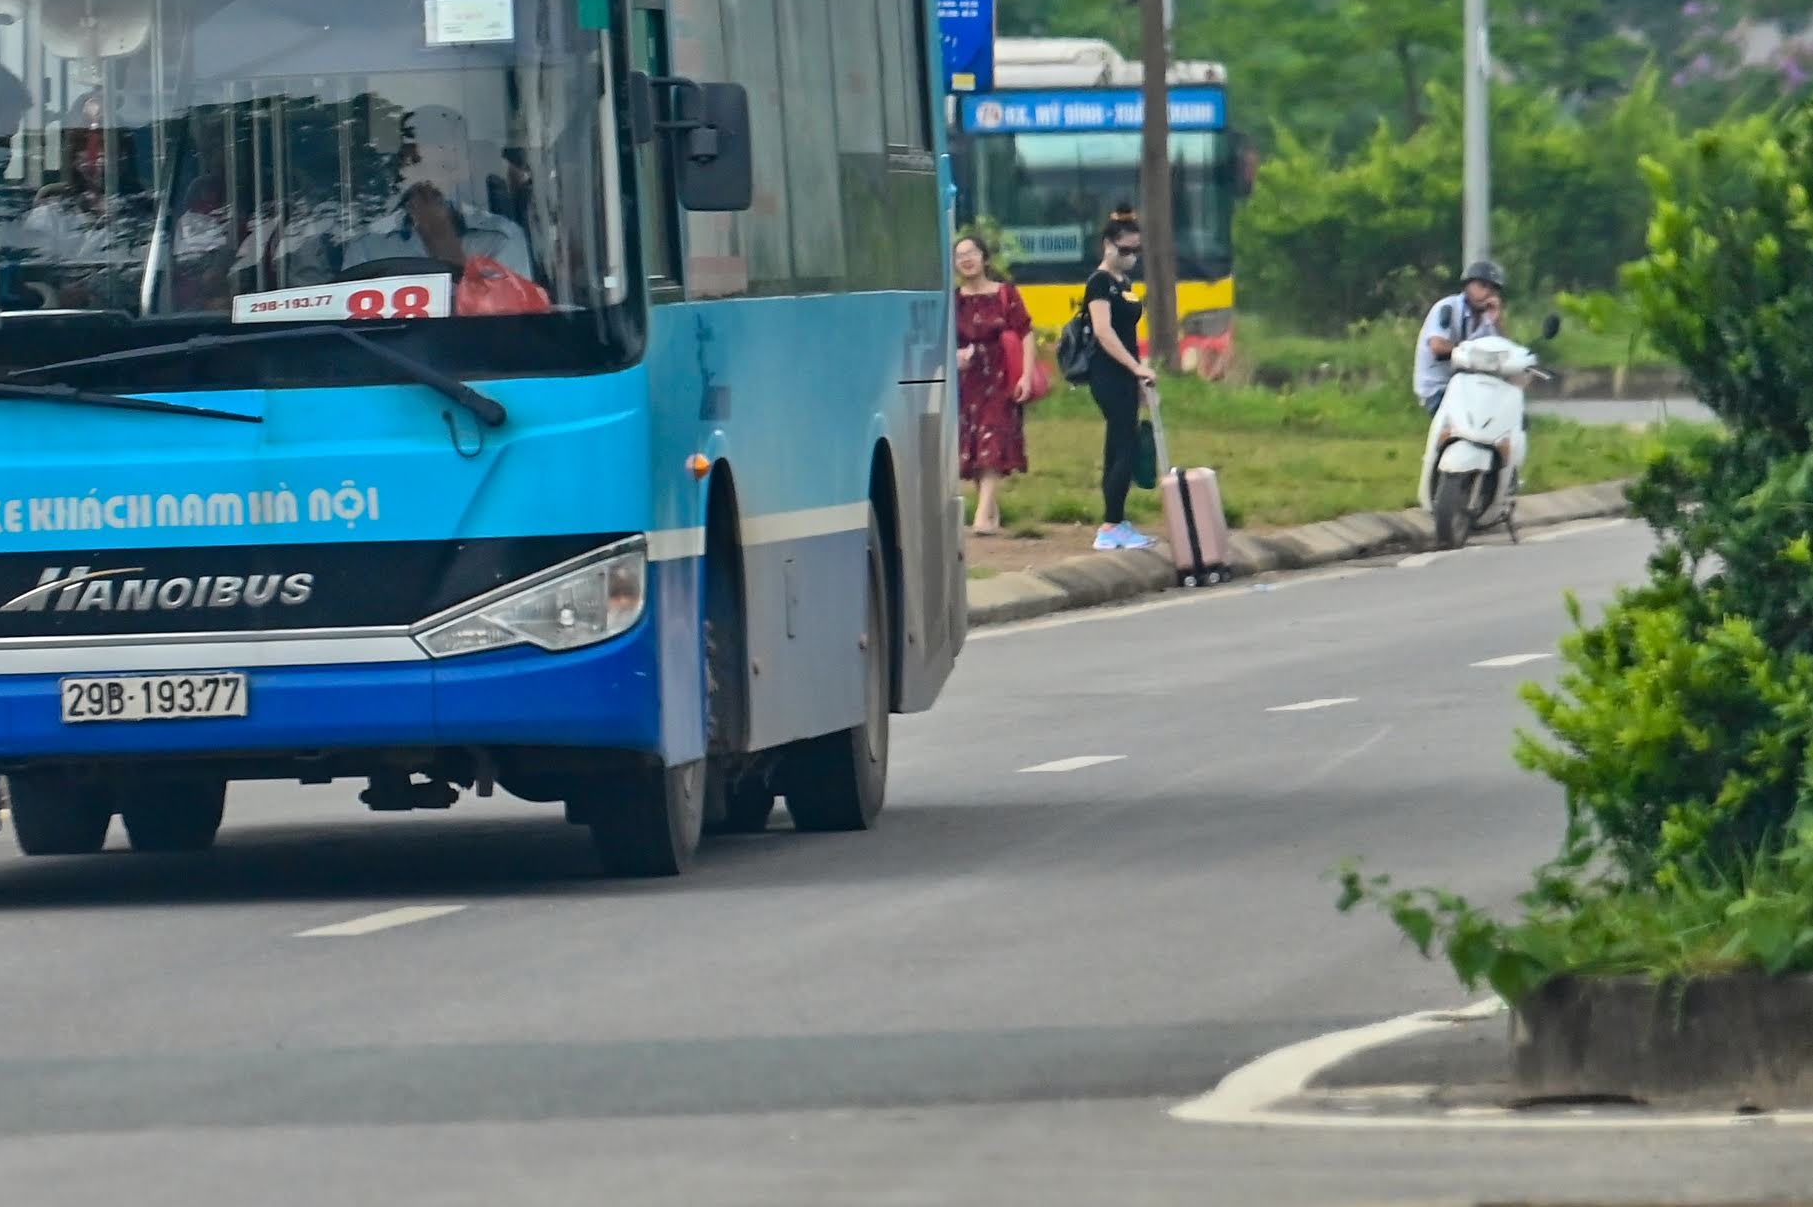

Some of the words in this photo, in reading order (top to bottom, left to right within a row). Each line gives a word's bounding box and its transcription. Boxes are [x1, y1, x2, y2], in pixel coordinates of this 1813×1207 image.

[249, 294, 333, 313] 29B-193.77
[346, 285, 430, 321] 88
[28, 487, 153, 532] KHÁCH
[155, 493, 244, 527] NAM
[247, 481, 299, 524] HÀ
[308, 479, 380, 530] NỘI
